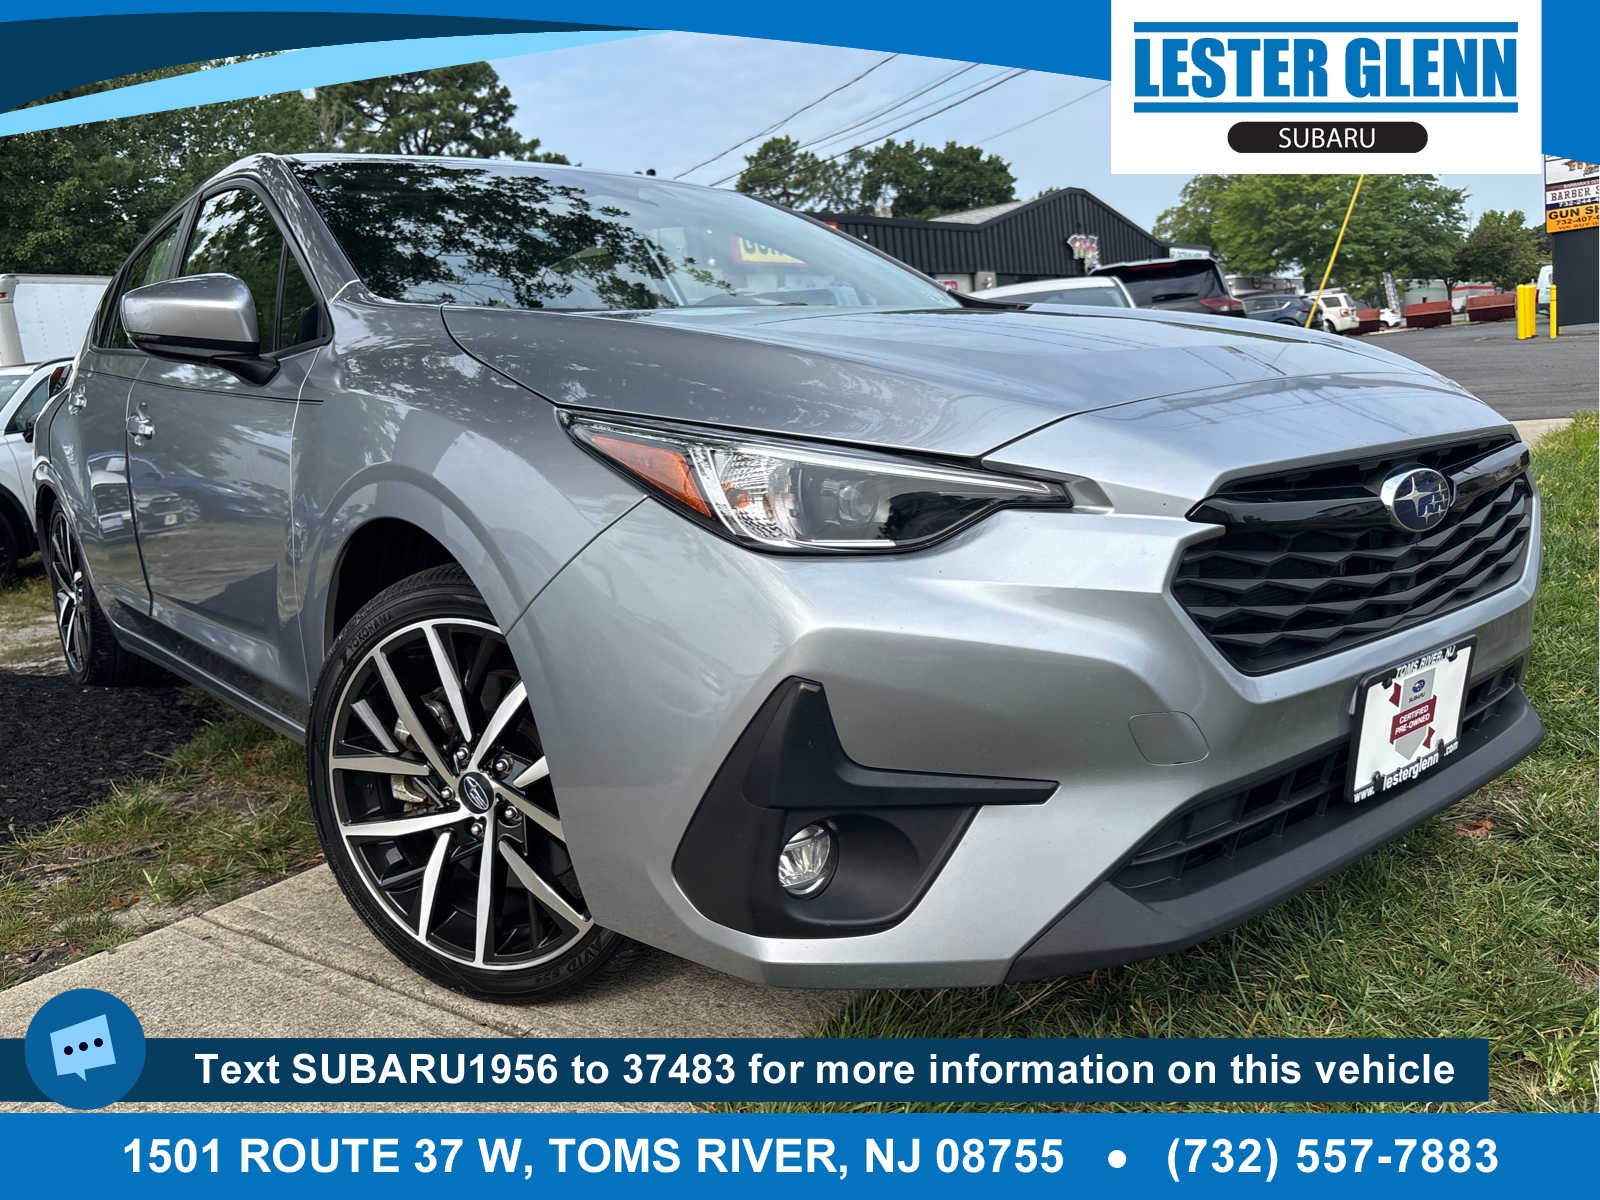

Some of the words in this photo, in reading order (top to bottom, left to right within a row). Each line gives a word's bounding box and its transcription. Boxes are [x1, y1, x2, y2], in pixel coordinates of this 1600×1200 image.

[1551, 187, 1591, 201] BARBER
[1548, 208, 1580, 220] GUN
[1396, 660, 1420, 678] TOMS
[1445, 645, 1456, 657] NJ
[1395, 712, 1431, 737] PRE-OWNED
[1399, 704, 1429, 725] CERTIFIED
[1353, 785, 1376, 804] www.
[1382, 752, 1439, 792] lesterglenn
[1443, 740, 1459, 757] .com
